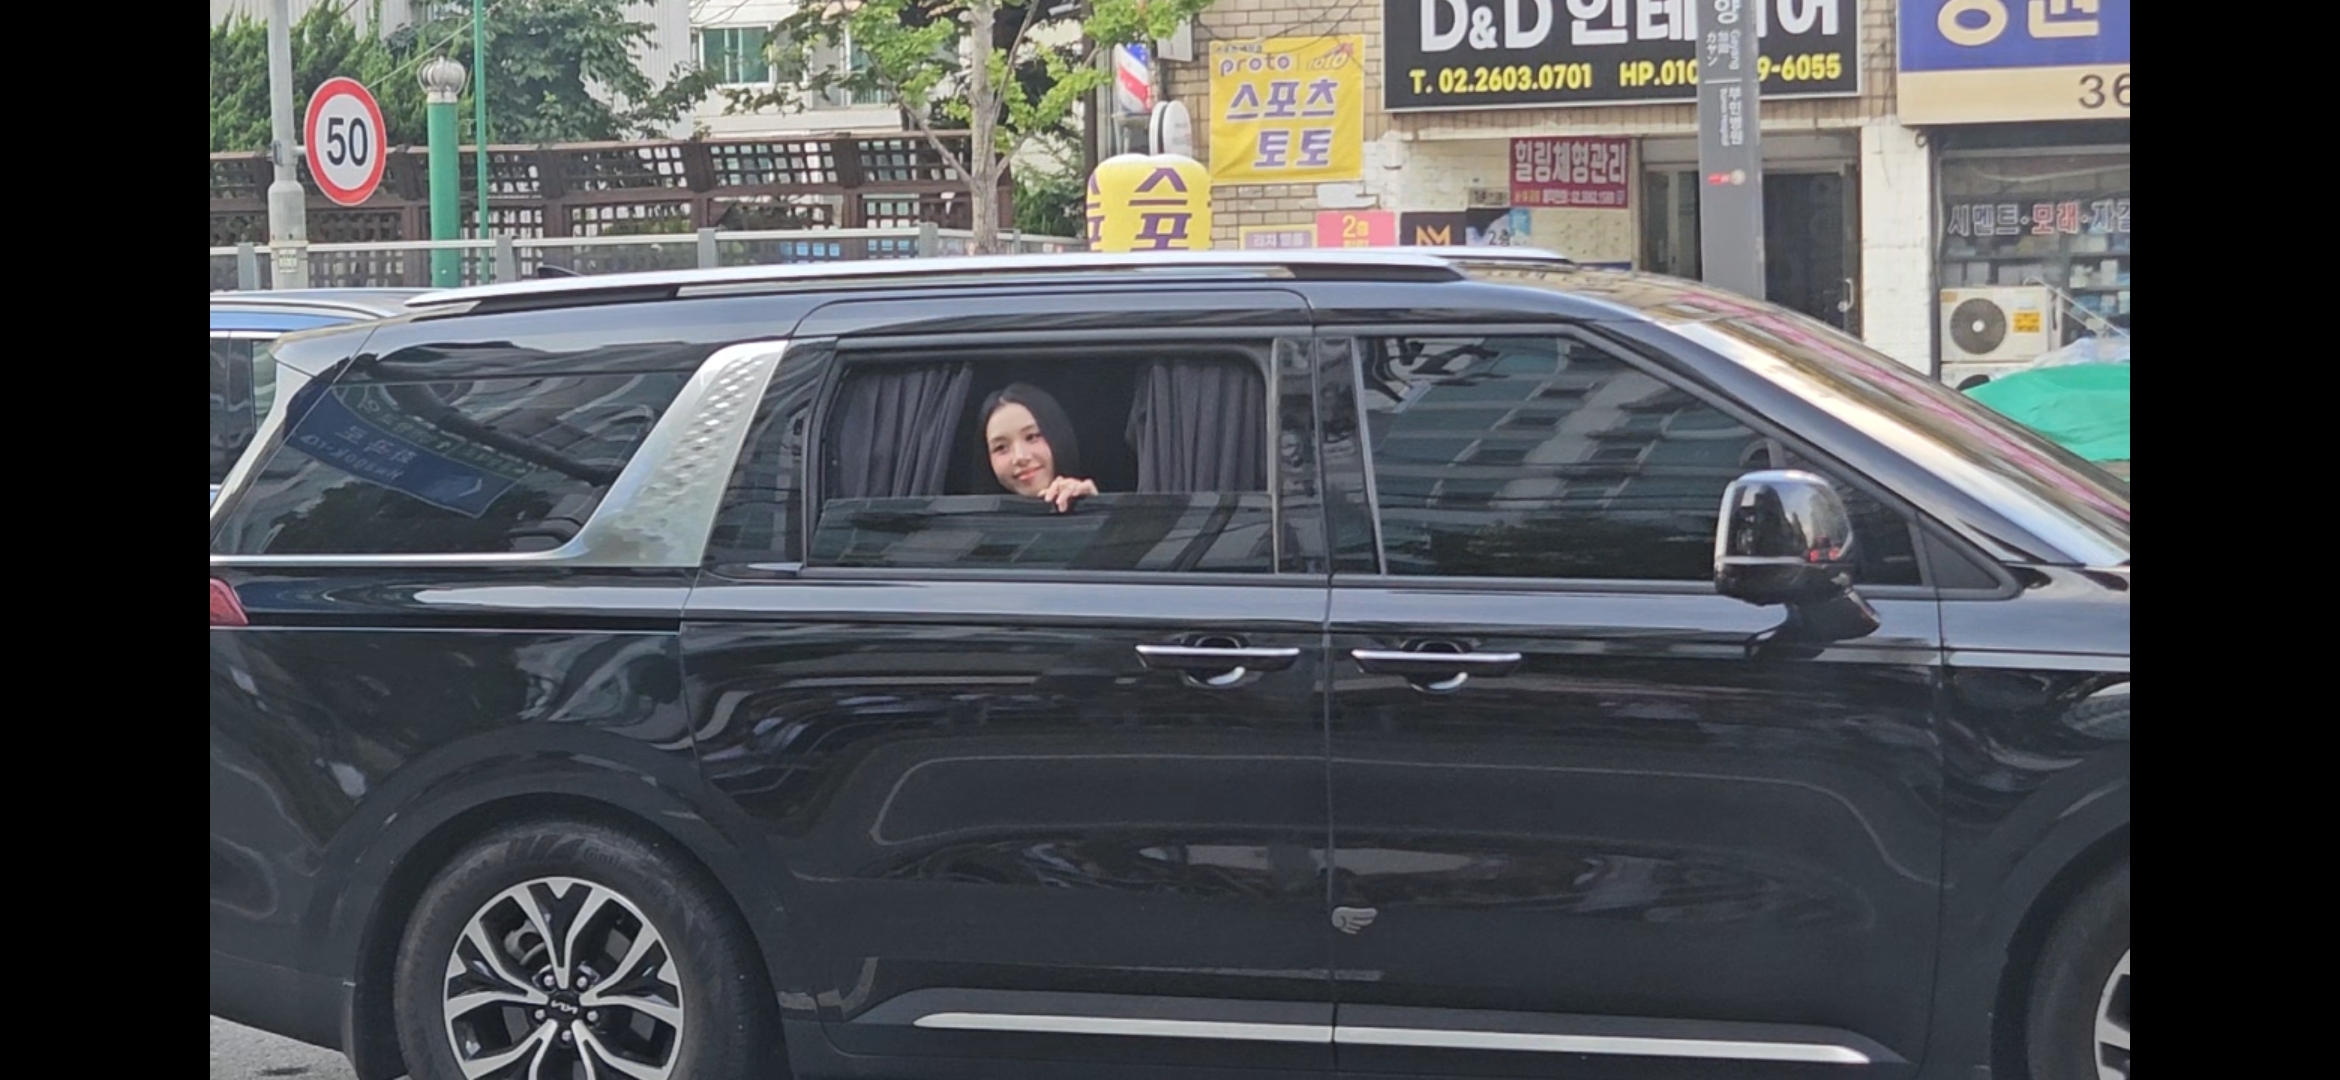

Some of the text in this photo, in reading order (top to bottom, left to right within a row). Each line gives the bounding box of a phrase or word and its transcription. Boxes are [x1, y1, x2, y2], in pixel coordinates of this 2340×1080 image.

[1420, 0, 1839, 52] D&D 인테어
[1220, 53, 1290, 77] proto
[1728, 29, 1741, 70] Gayang
[1409, 68, 1433, 94] T.
[1438, 62, 1593, 94] 02.2603.0701
[1226, 79, 1339, 120] 스포츠
[325, 116, 368, 167] 50
[1254, 130, 1332, 168] 토토
[1515, 141, 1626, 184] 힐링체형관리
